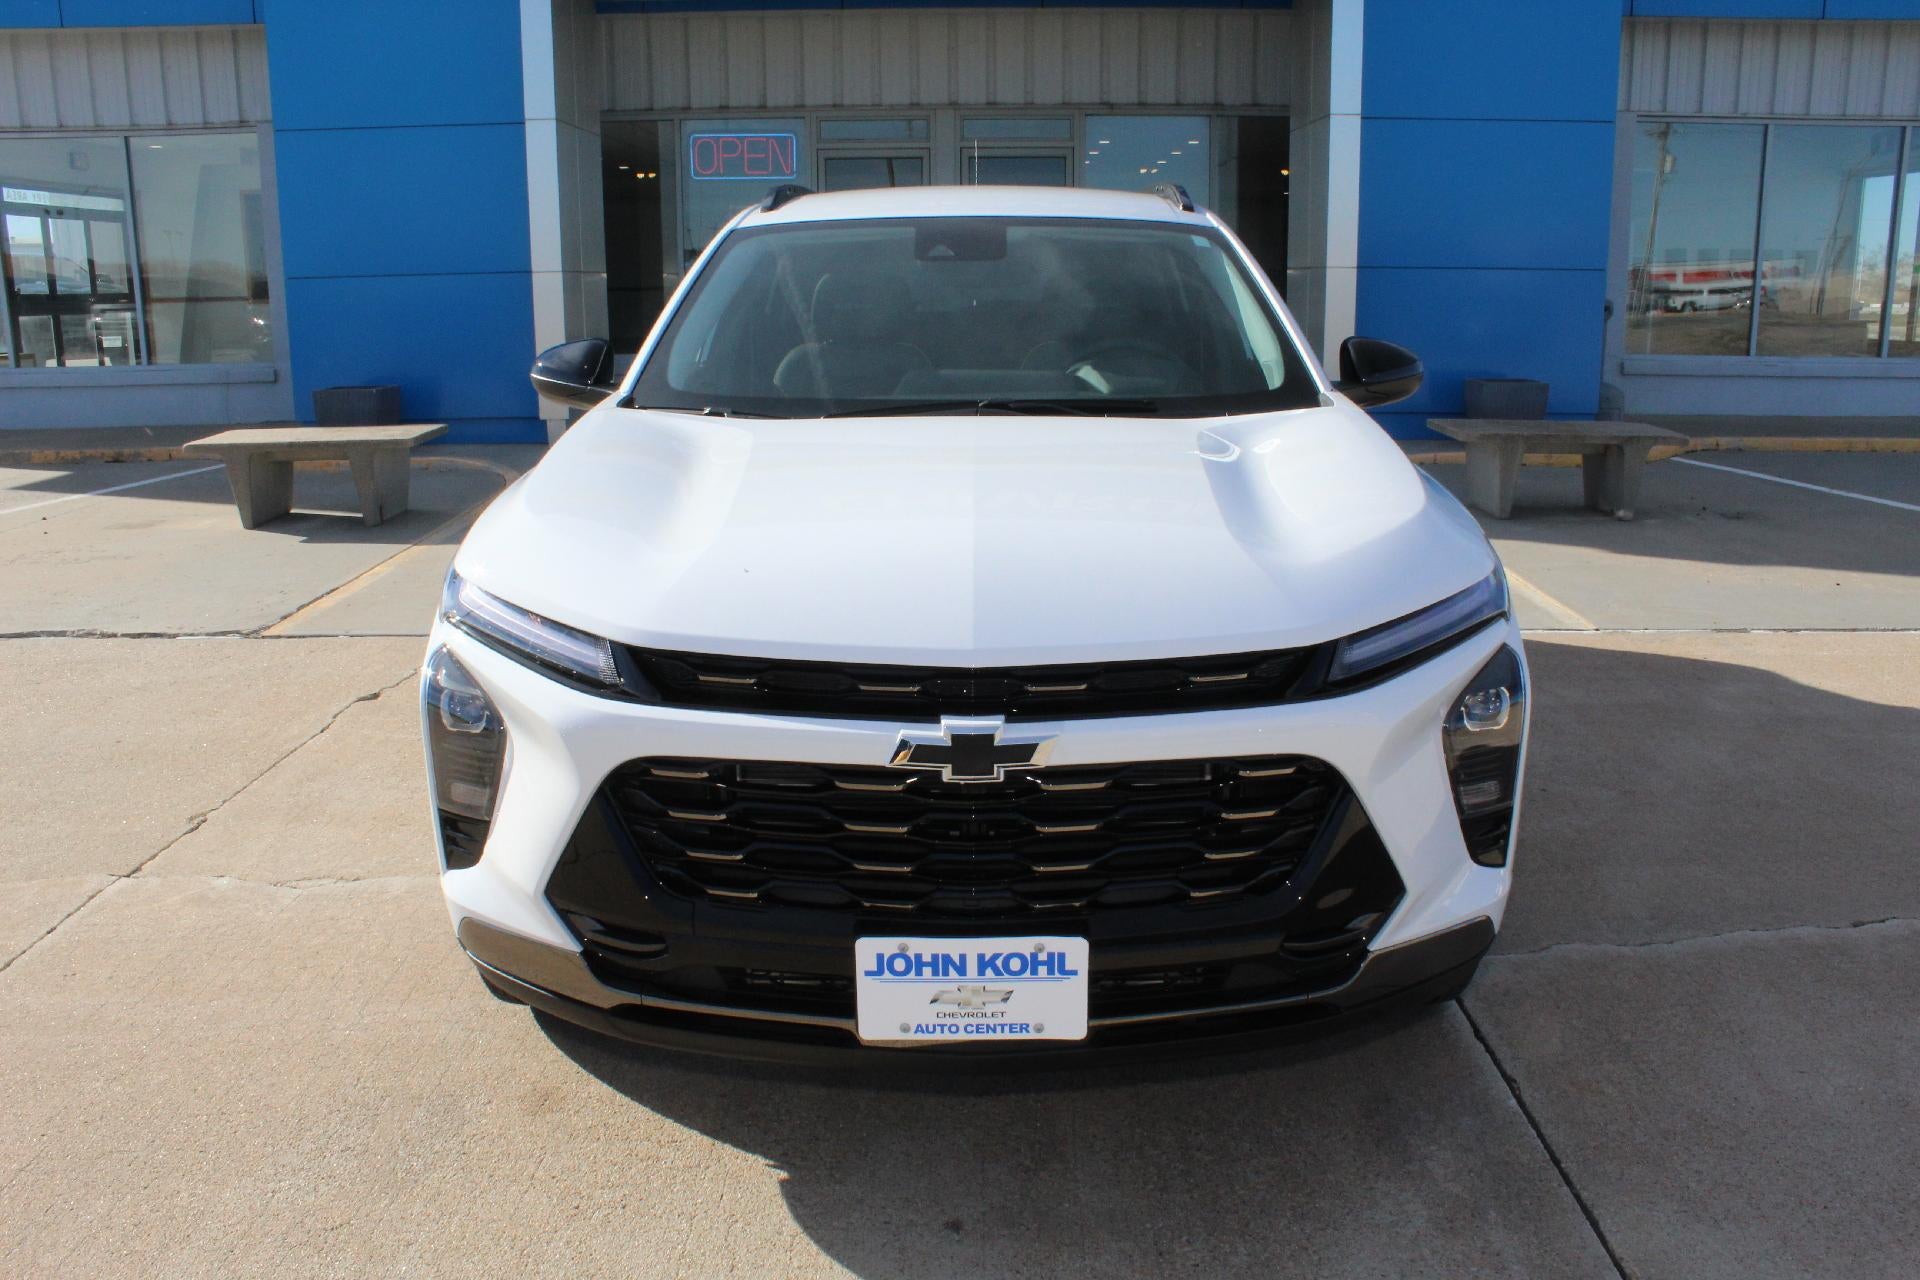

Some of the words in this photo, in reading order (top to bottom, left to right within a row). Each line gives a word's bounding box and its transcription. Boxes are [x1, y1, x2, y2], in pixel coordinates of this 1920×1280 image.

[694, 137, 792, 175] OPEN
[864, 952, 967, 977] JOHN
[976, 951, 1079, 976] KOHL
[936, 1011, 1007, 1019] CHEVROLET
[913, 1023, 960, 1034] AUTO
[963, 1022, 1030, 1034] CENTER
